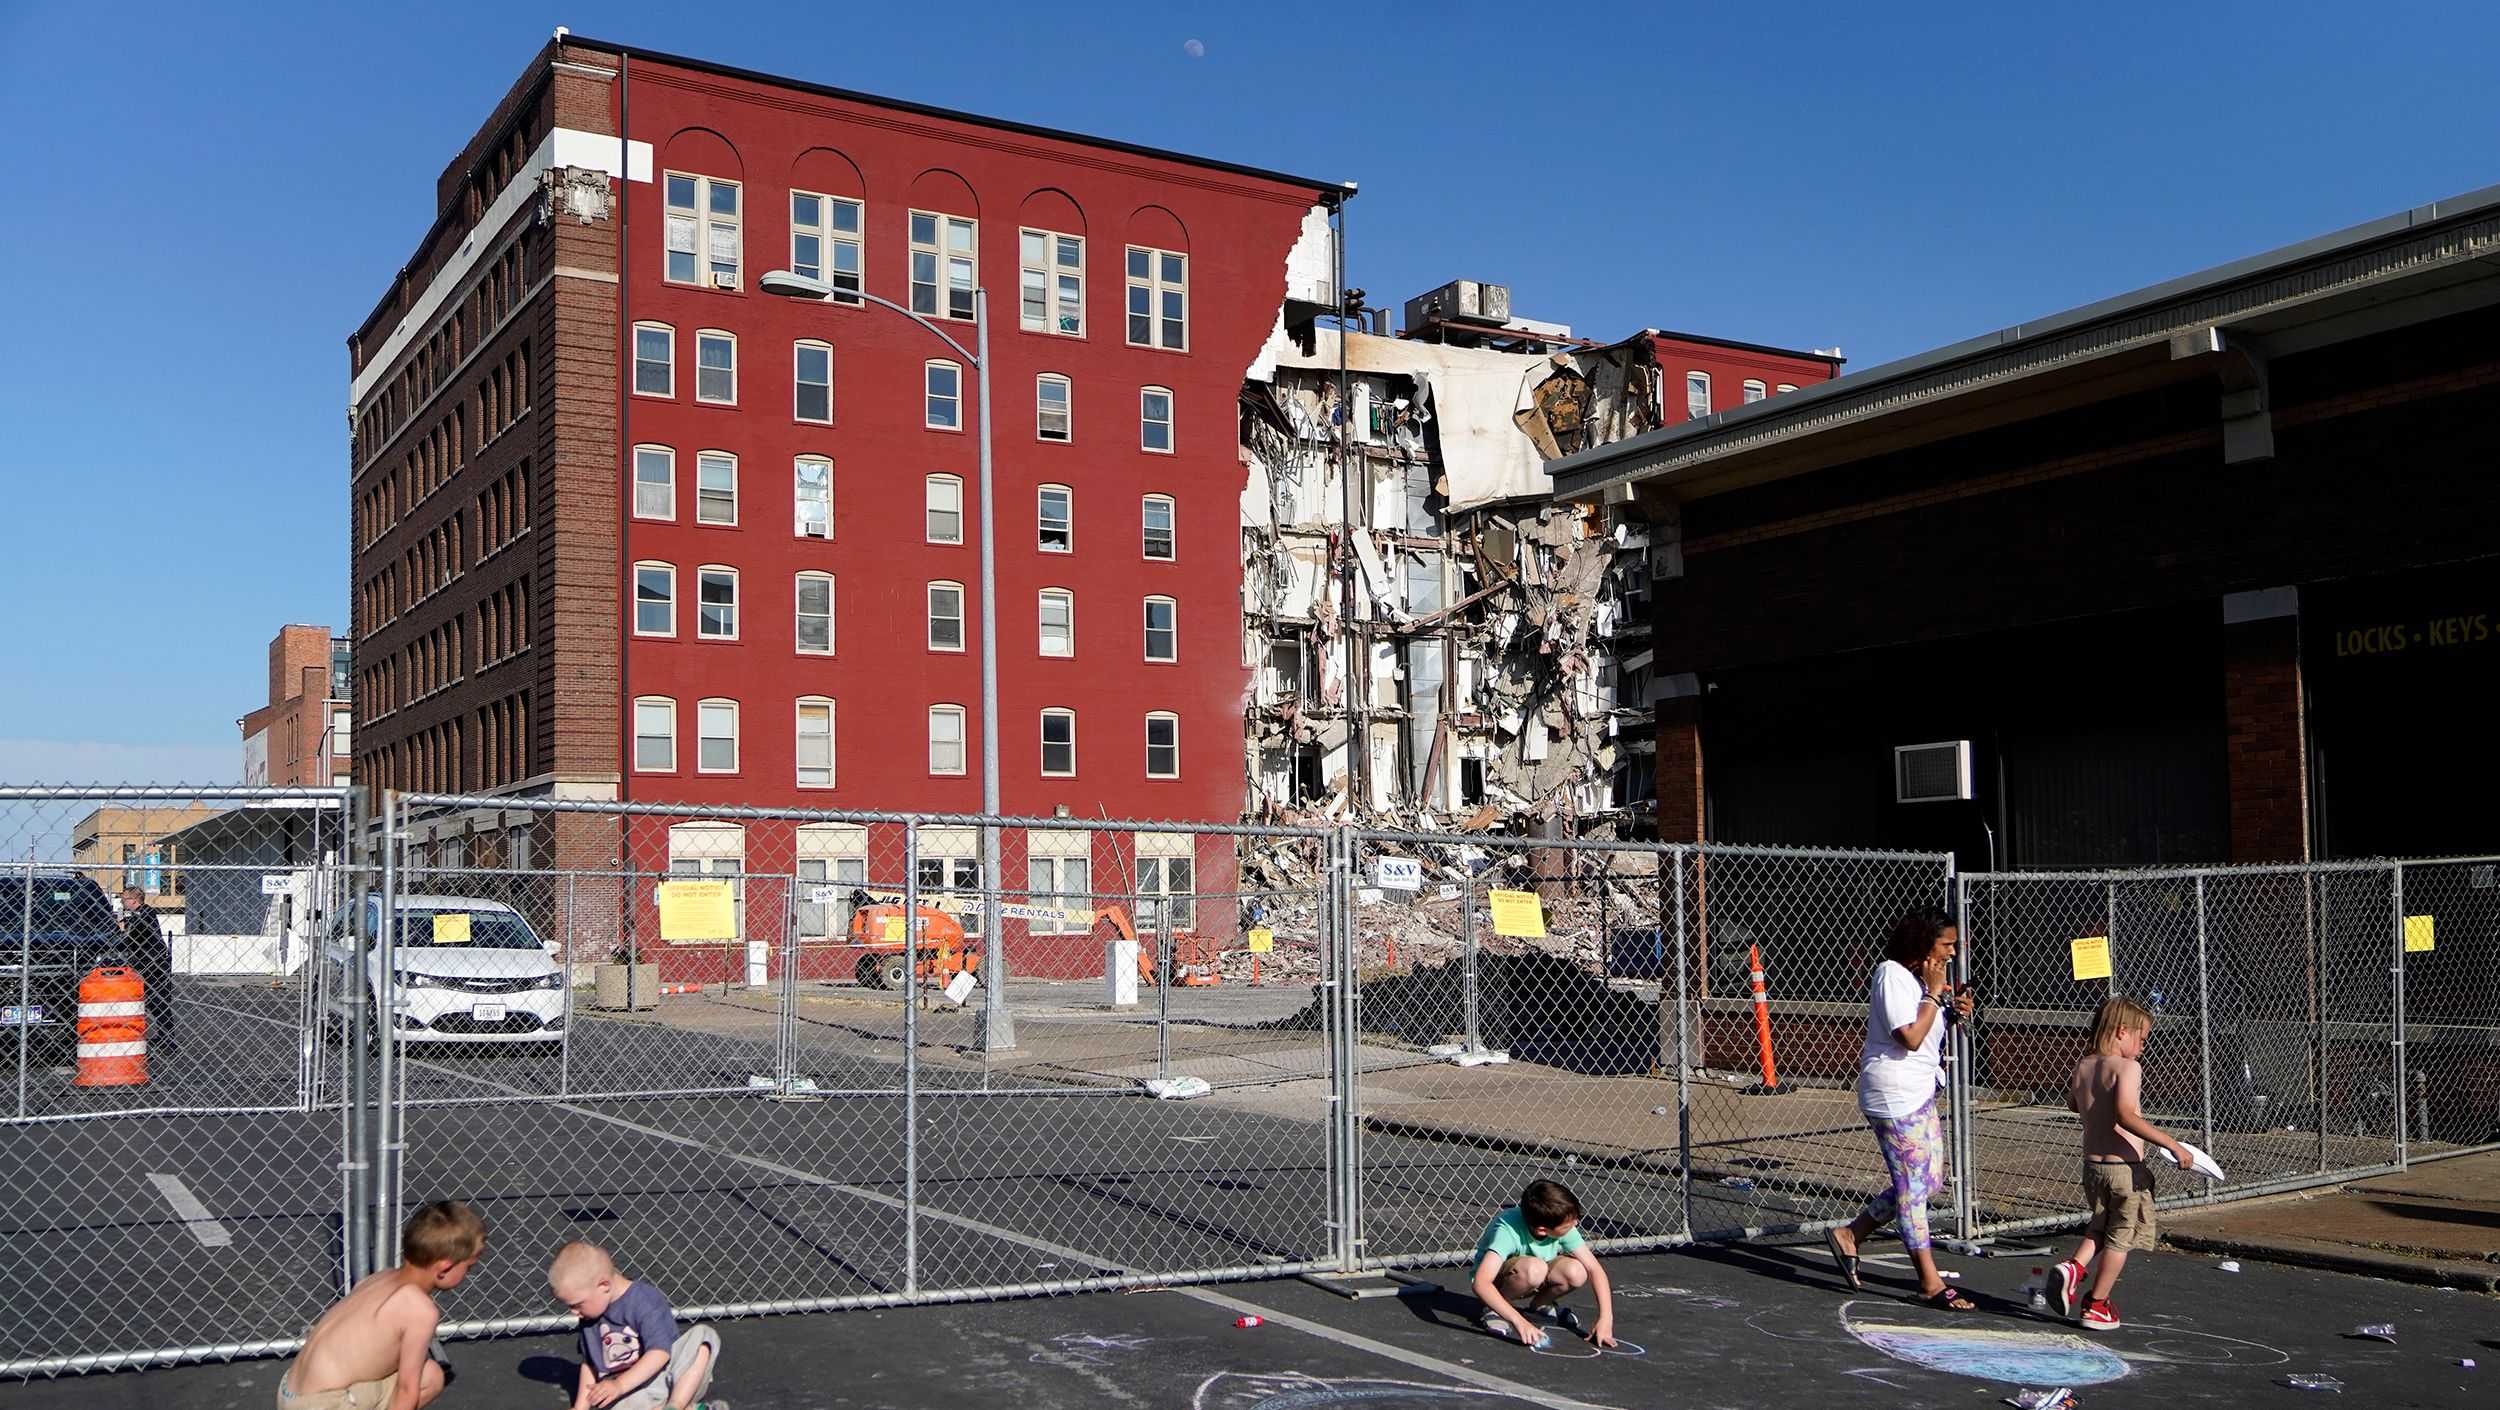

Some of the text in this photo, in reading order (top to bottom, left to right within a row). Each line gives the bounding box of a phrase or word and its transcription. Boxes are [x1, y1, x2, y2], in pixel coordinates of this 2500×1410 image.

[2336, 614, 2488, 656] LOCKS KEYS
[1383, 863, 1416, 876] S&V
[879, 896, 901, 904] JLG
[1010, 907, 1065, 919] RENTALS
